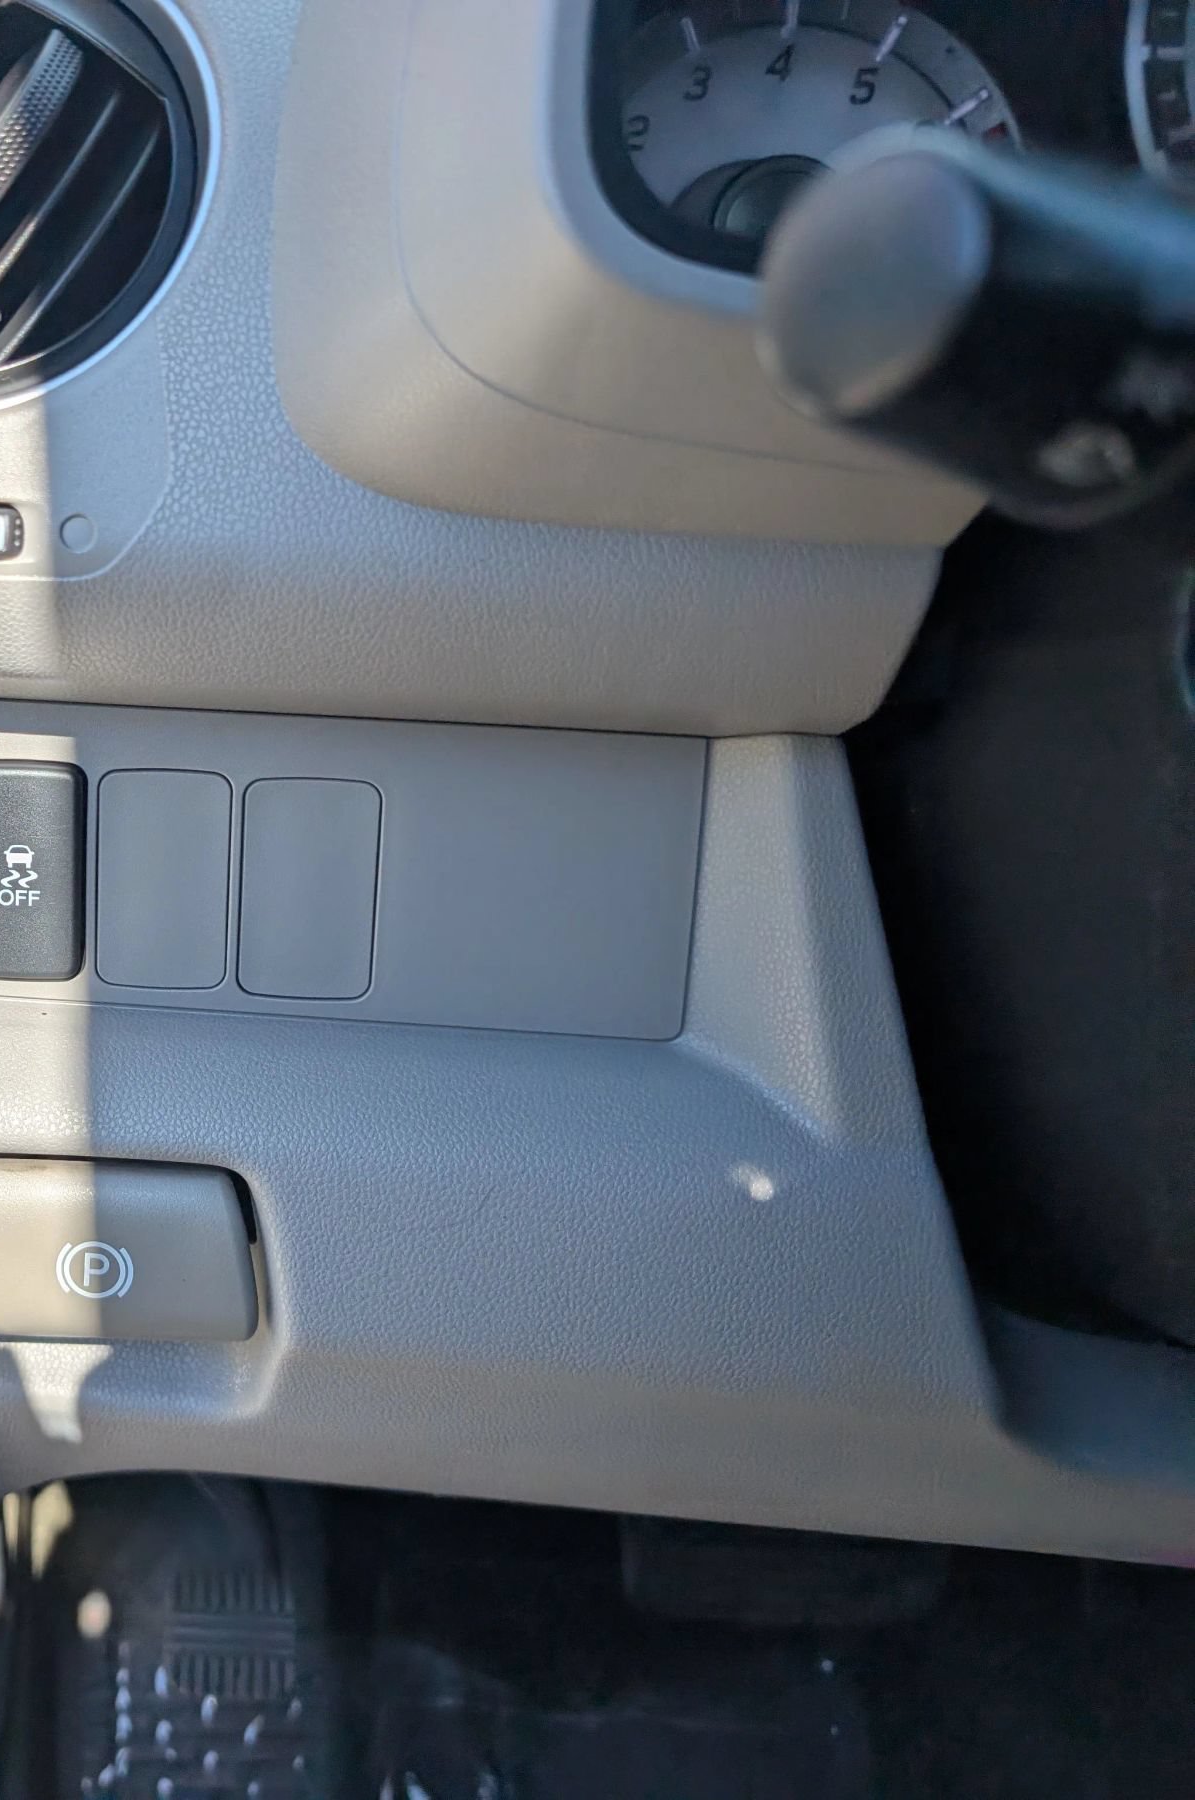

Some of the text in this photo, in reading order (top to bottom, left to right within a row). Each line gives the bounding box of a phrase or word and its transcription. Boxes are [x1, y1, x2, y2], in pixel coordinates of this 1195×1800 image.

[765, 43, 795, 83] 4
[683, 65, 712, 102] 3
[849, 67, 879, 106] 5
[83, 1252, 110, 1287] P
